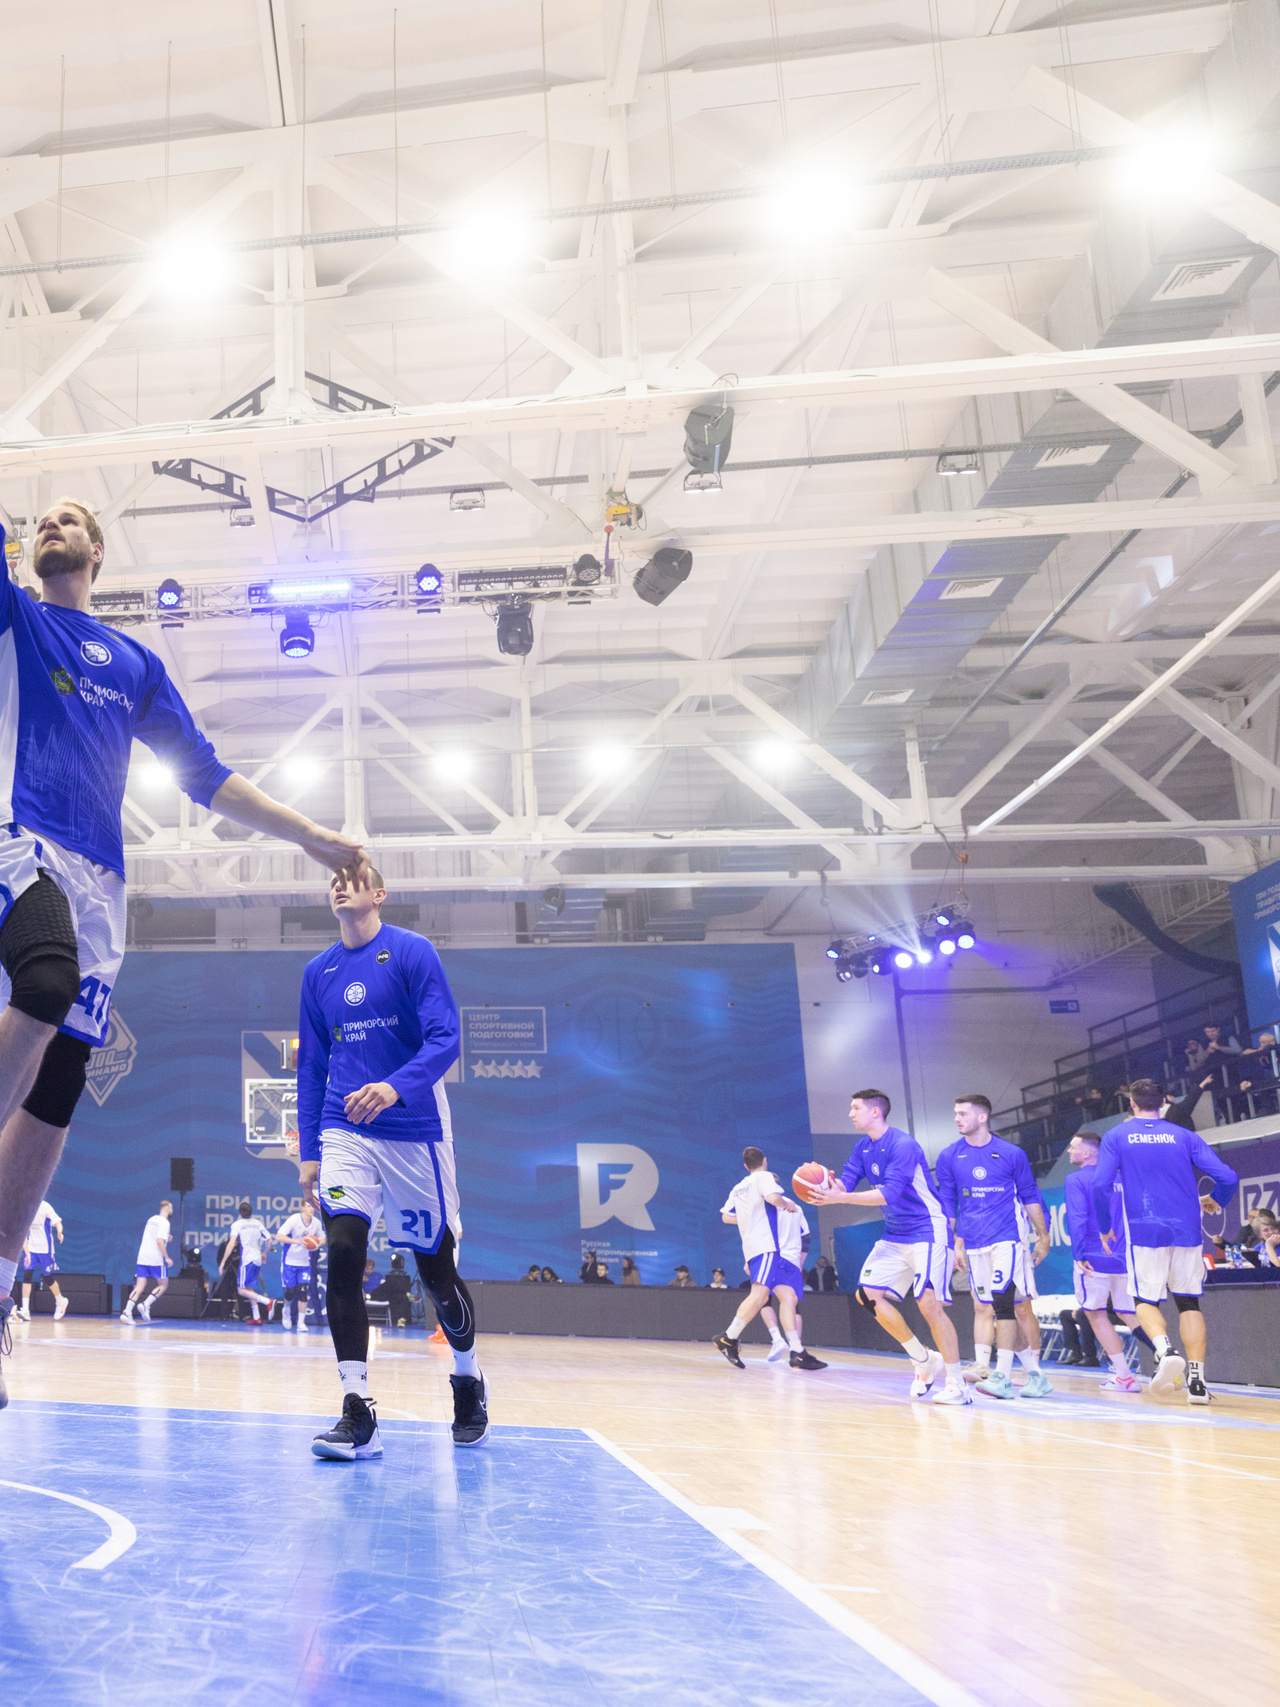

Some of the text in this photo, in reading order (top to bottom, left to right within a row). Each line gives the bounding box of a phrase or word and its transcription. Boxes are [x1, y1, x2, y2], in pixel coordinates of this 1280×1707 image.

[74, 975, 112, 1024] 41
[343, 1015, 398, 1032] ПРИМОРСКИЙ
[469, 1014, 500, 1022] ЦЕНТР
[469, 1022, 534, 1030] СПОРТИВНОЙ
[345, 1030, 366, 1042] КРАЙ
[470, 1031, 534, 1039] ПОДГОТОВКИ
[86, 1063, 128, 1078] ИНАМО
[1128, 1134, 1176, 1144] СЕМЕНЮК
[400, 1209, 432, 1239] 21
[581, 1240, 611, 1248] Русская
[992, 1270, 1004, 1284] 3
